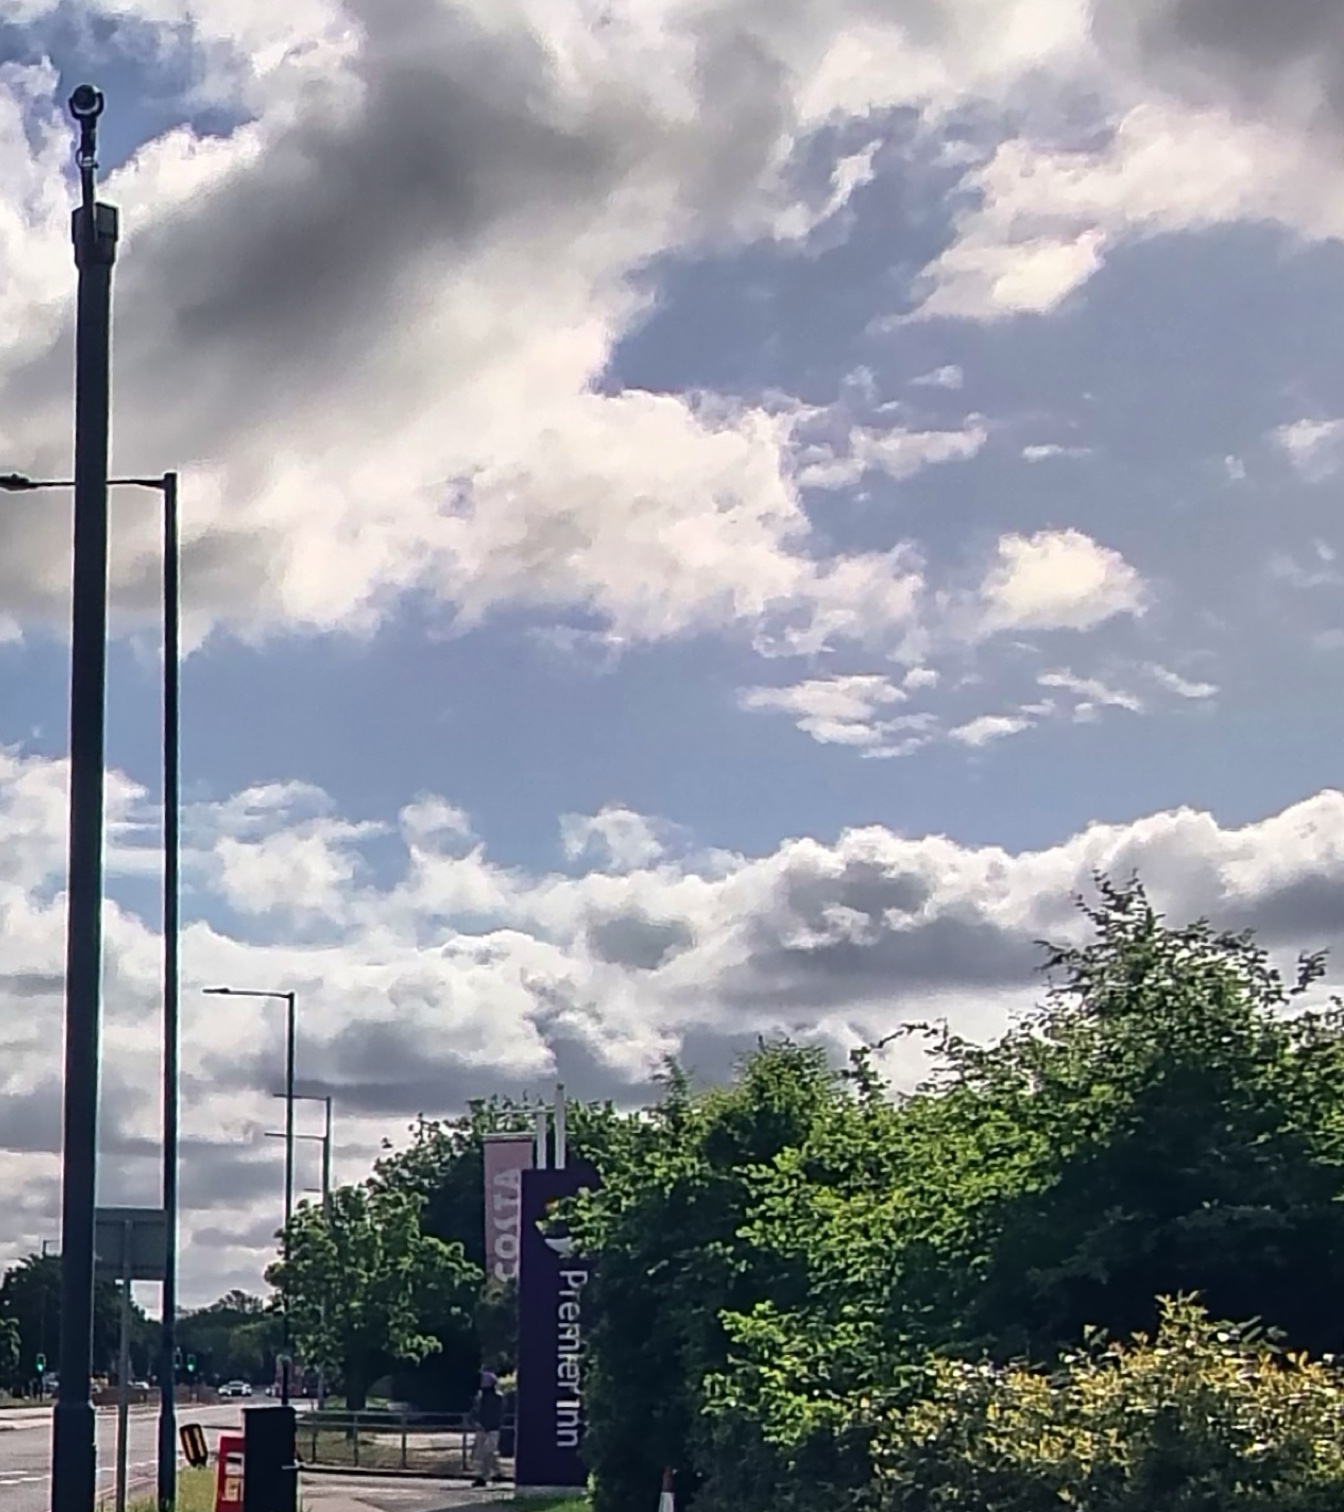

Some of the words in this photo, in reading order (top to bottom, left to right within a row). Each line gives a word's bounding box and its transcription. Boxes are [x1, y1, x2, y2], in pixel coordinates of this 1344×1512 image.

[493, 1168, 520, 1283] COSTA
[556, 1270, 588, 1392] Premier
[555, 1398, 581, 1448] Inn
